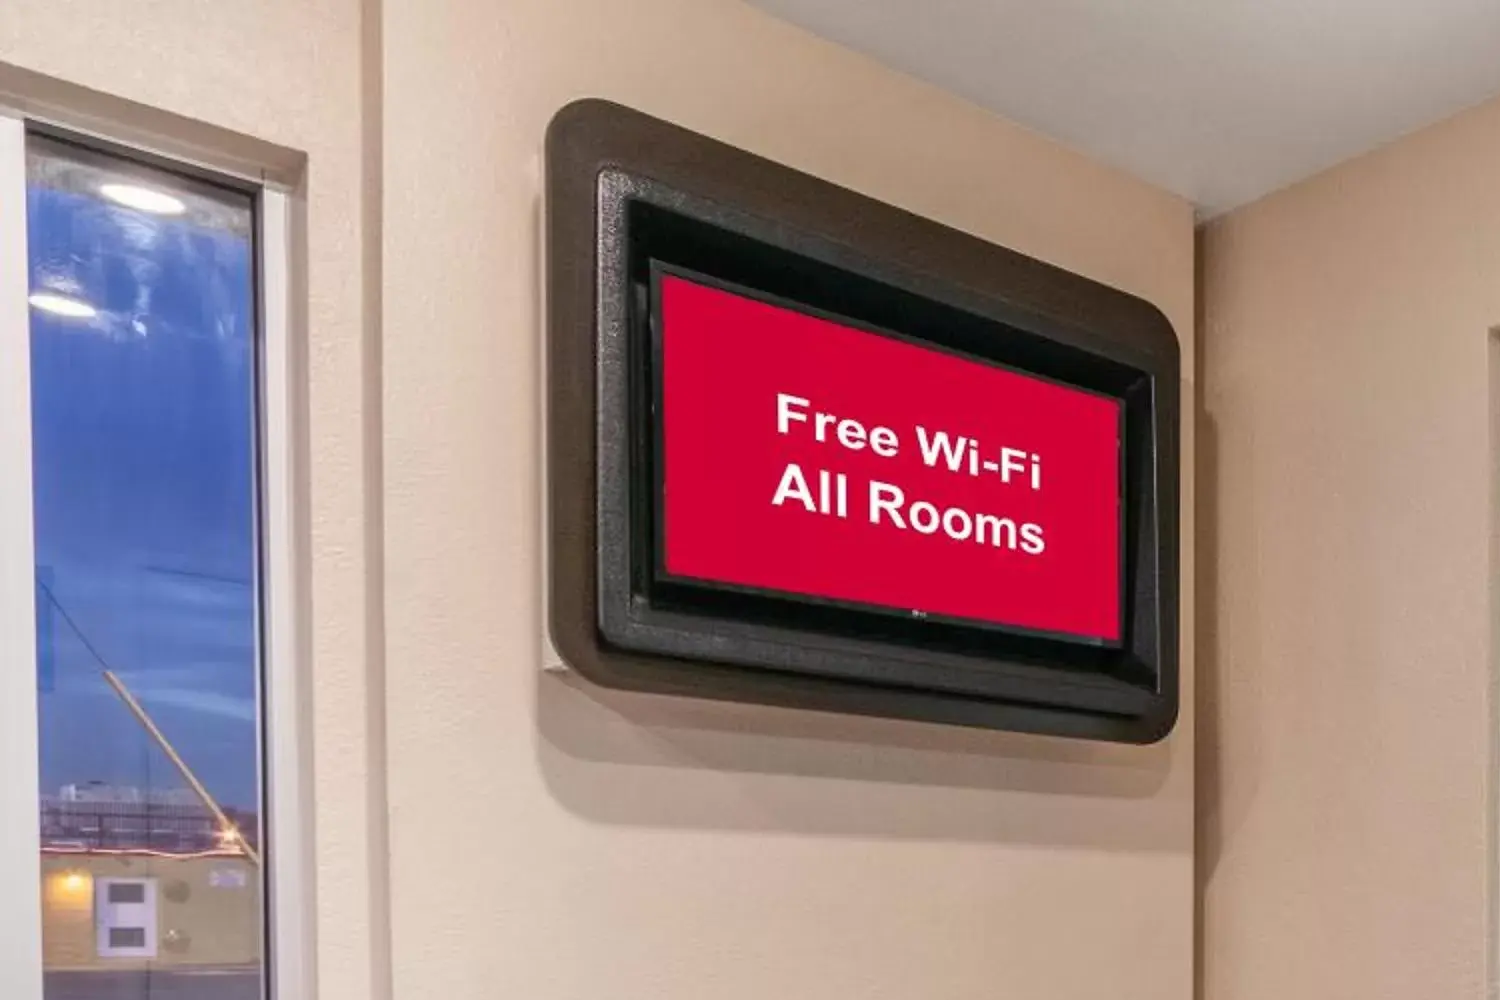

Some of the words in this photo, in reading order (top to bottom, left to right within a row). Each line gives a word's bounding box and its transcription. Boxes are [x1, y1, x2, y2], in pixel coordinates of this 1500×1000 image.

[777, 392, 899, 457] Free
[915, 425, 1041, 490] Wi-Fi
[771, 463, 847, 518] All
[869, 479, 1045, 554] Rooms
